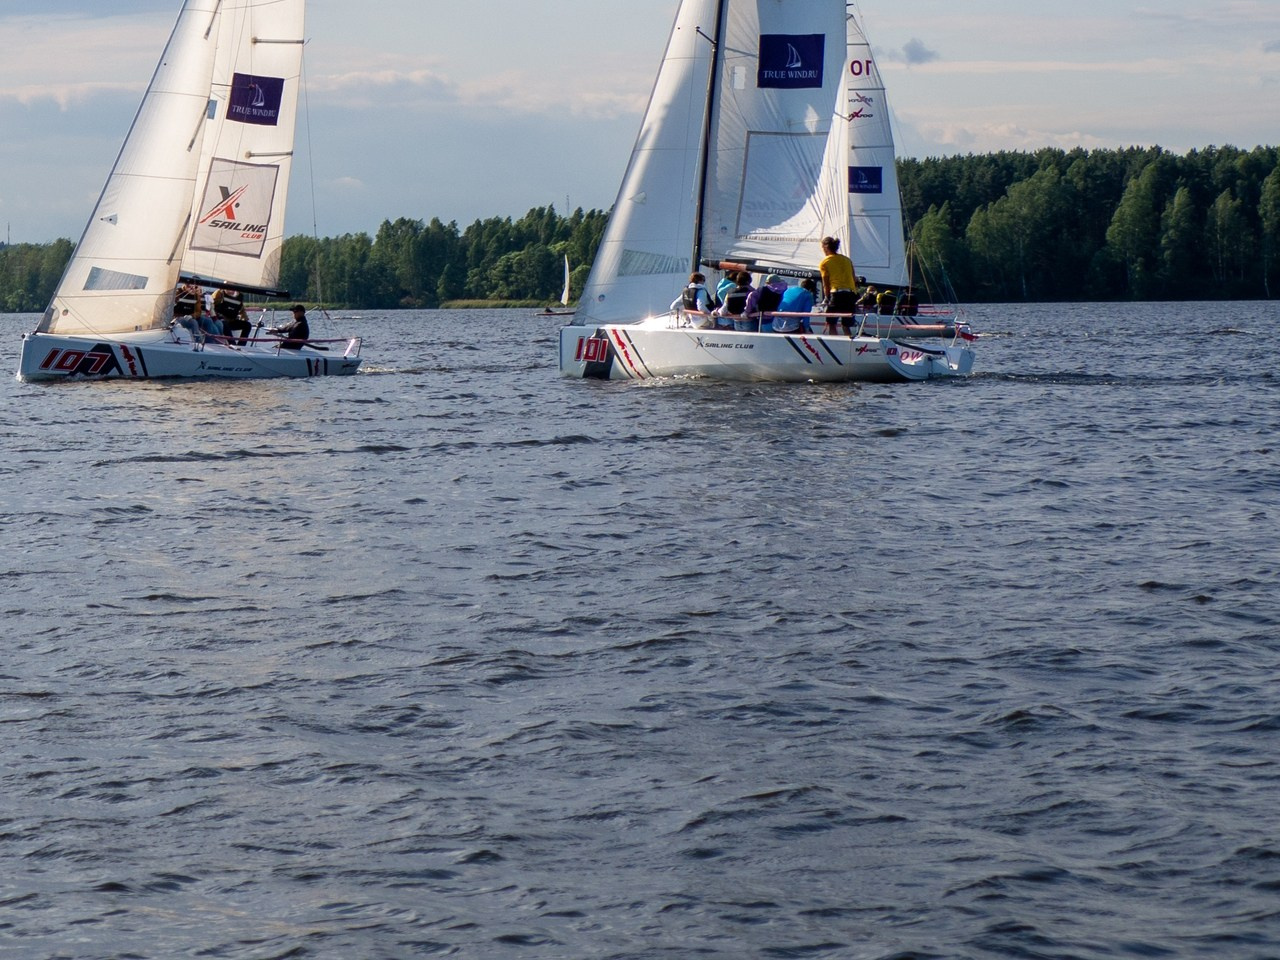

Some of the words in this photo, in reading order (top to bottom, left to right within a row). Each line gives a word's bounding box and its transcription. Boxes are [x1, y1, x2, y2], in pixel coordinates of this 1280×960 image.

[763, 70, 786, 79] TRUE
[232, 104, 252, 115] TRUE
[208, 219, 268, 233] SAILING
[240, 232, 263, 240] CLUB
[574, 335, 609, 363] 101
[38, 346, 112, 374] 107
